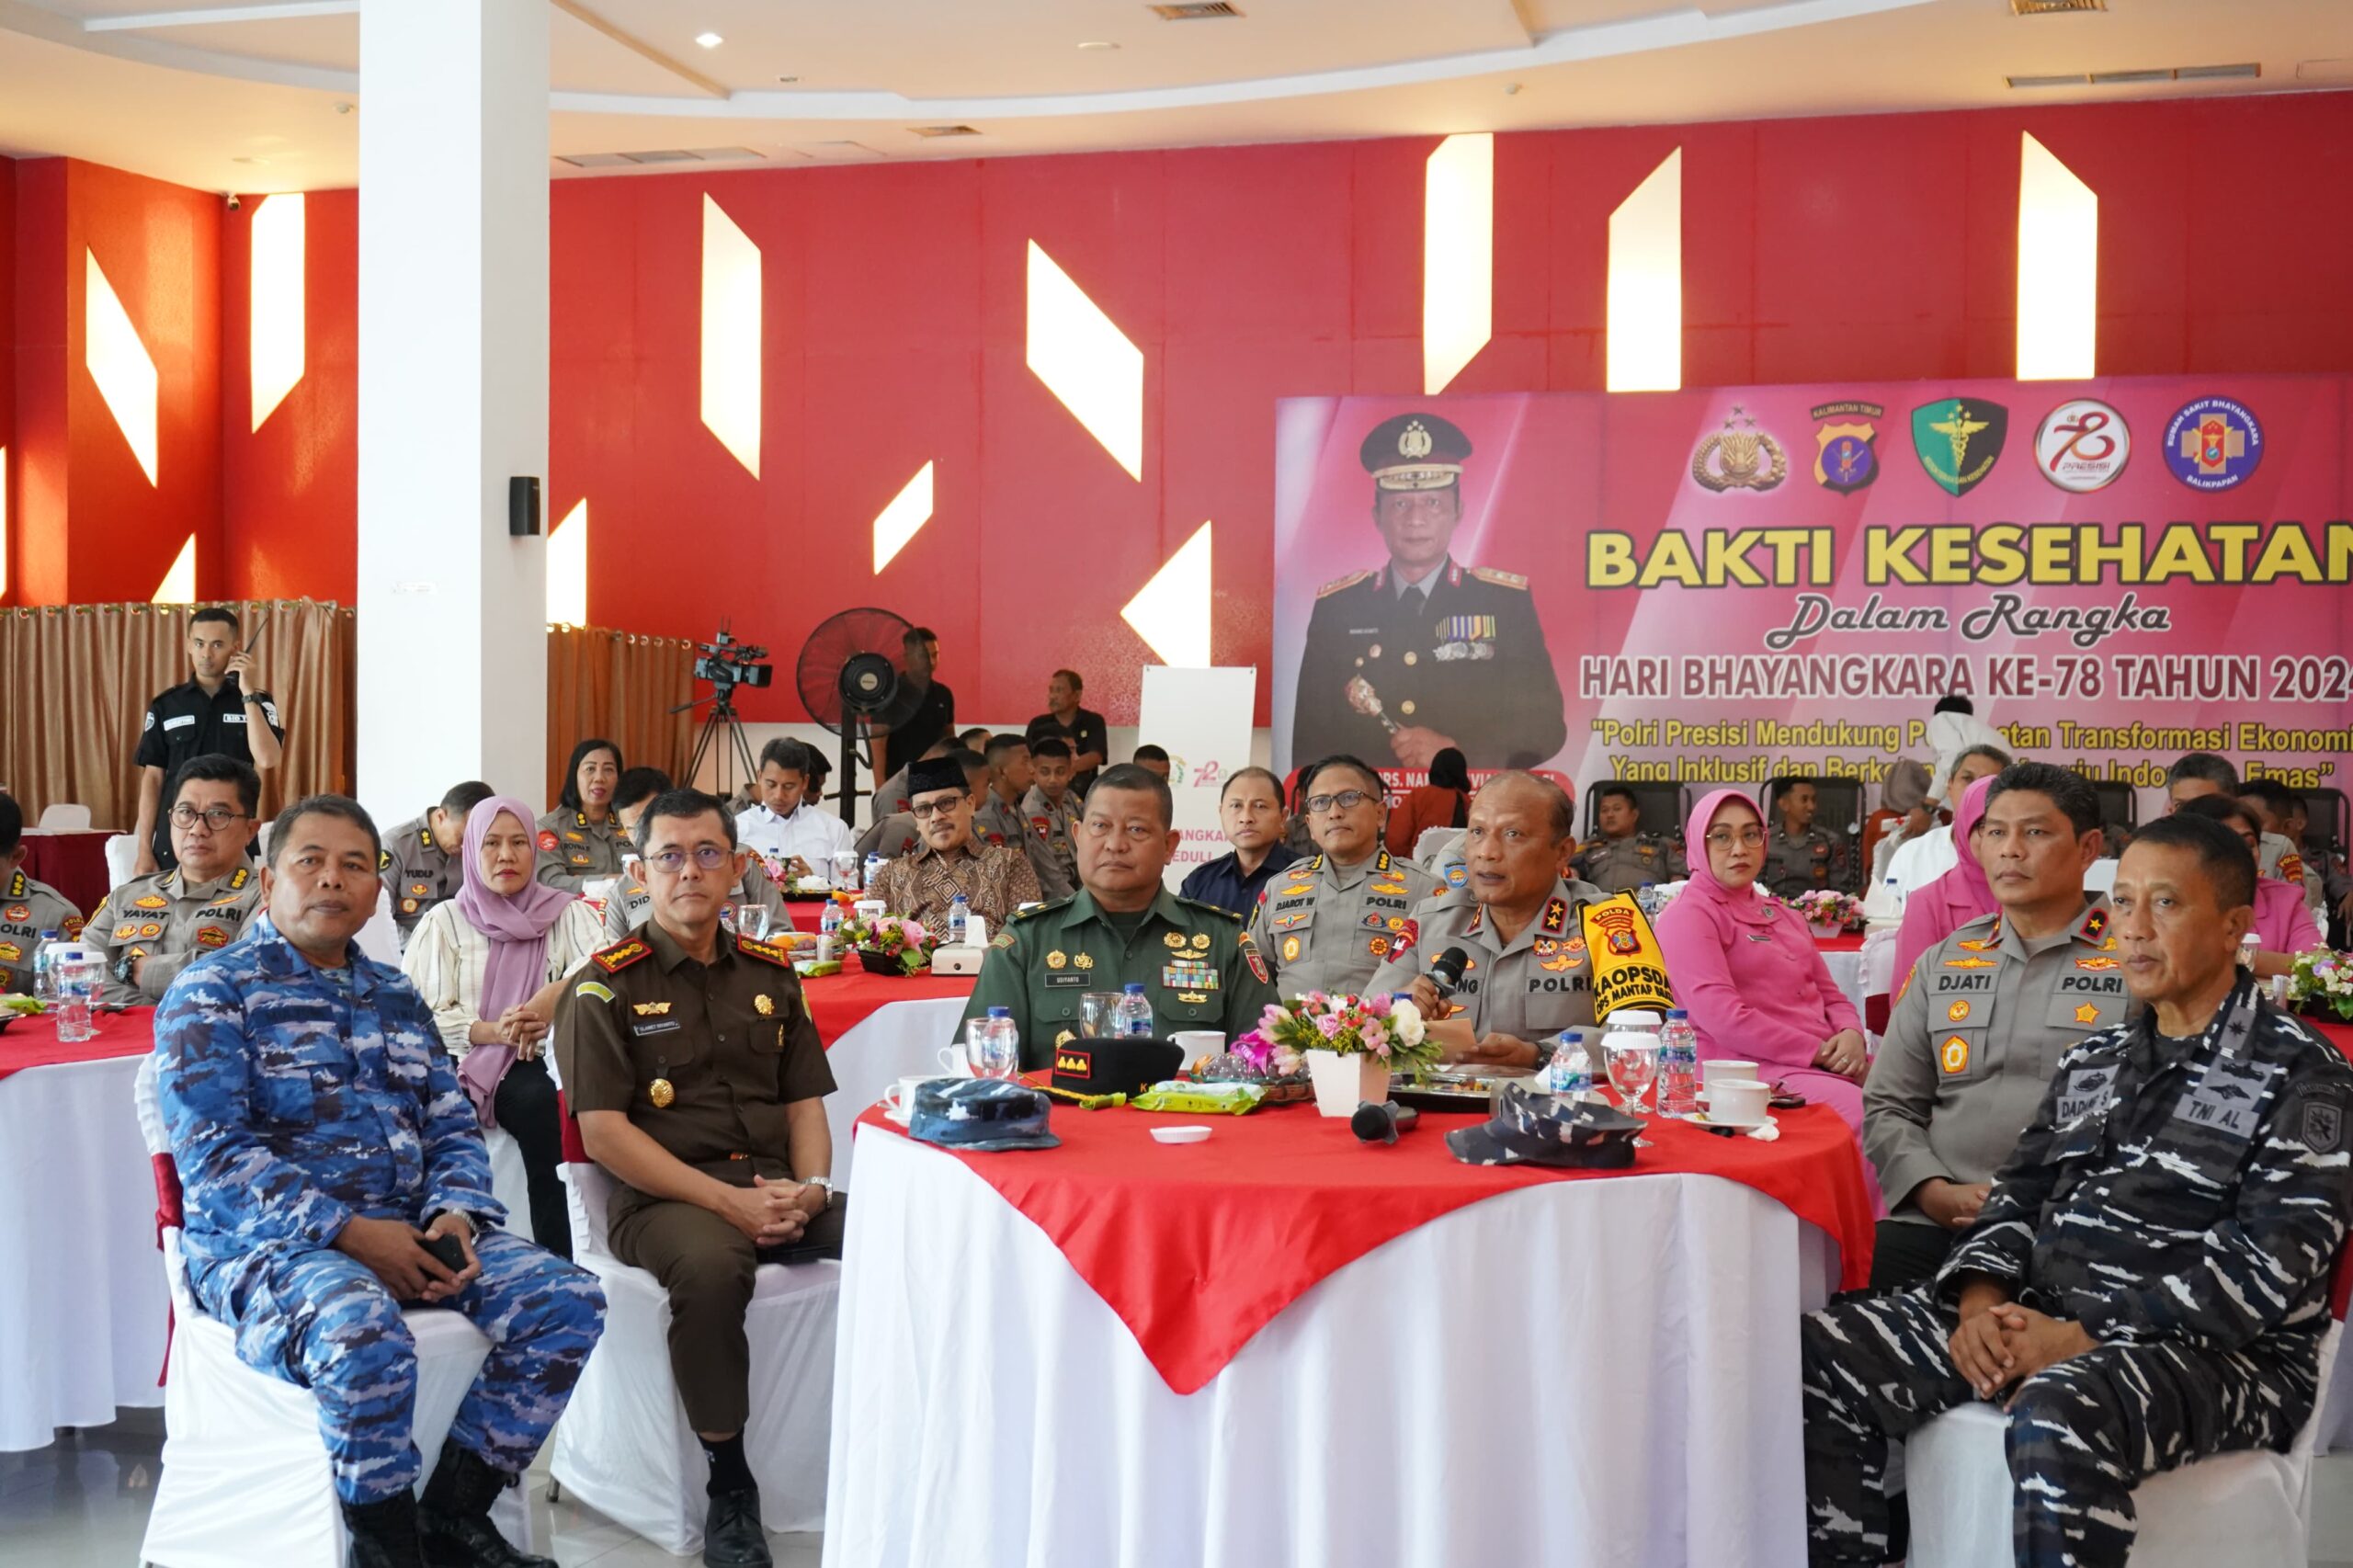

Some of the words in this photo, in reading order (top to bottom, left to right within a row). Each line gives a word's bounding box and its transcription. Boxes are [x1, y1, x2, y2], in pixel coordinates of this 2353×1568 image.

[1813, 403, 1858, 417] KALIMANTAN
[1859, 404, 1882, 416] TIMUR
[2167, 415, 2184, 447] RUMAH
[2184, 401, 2210, 418] SAKIT
[2211, 399, 2259, 447] BHAYANGKARA
[2187, 474, 2239, 488] BALIKPAPAN
[1587, 527, 1834, 588] BAKTI
[1865, 523, 2353, 585] KESEHATAN
[1765, 593, 1949, 649] Dalam
[1961, 593, 2170, 647] Rangka
[1582, 657, 1668, 697] HARI
[1683, 656, 1974, 697] BHAYANGKARA
[1988, 656, 2103, 698] KE-78
[2114, 657, 2258, 699] TAHUN
[1591, 720, 1658, 746] "Polri
[1666, 720, 1748, 747] Presisi
[1756, 721, 1901, 752] Mendukung
[2058, 722, 2230, 750] Transformasi
[2238, 722, 2353, 752] Ekonomi
[1610, 756, 1669, 781] Yang
[1678, 756, 1767, 782] Inklusif
[1773, 756, 1818, 779] dan
[1173, 850, 1212, 862] EDULI
[1276, 898, 1305, 912] DJAROT
[1306, 897, 1315, 906] W
[1366, 897, 1407, 910] POLRI
[122, 909, 171, 919] YAYAT
[195, 907, 242, 920] POLRI
[1595, 907, 1631, 922] POLDA
[0, 923, 37, 938] OLRI
[1529, 975, 1591, 994] POLRI
[1938, 974, 1991, 992] DJATI
[2061, 976, 2123, 994] POLRI
[1597, 996, 1610, 1016] OPS
[1612, 983, 1653, 1003] MANTAP
[2189, 1100, 2217, 1120] TNI
[2219, 1108, 2241, 1130] AL
